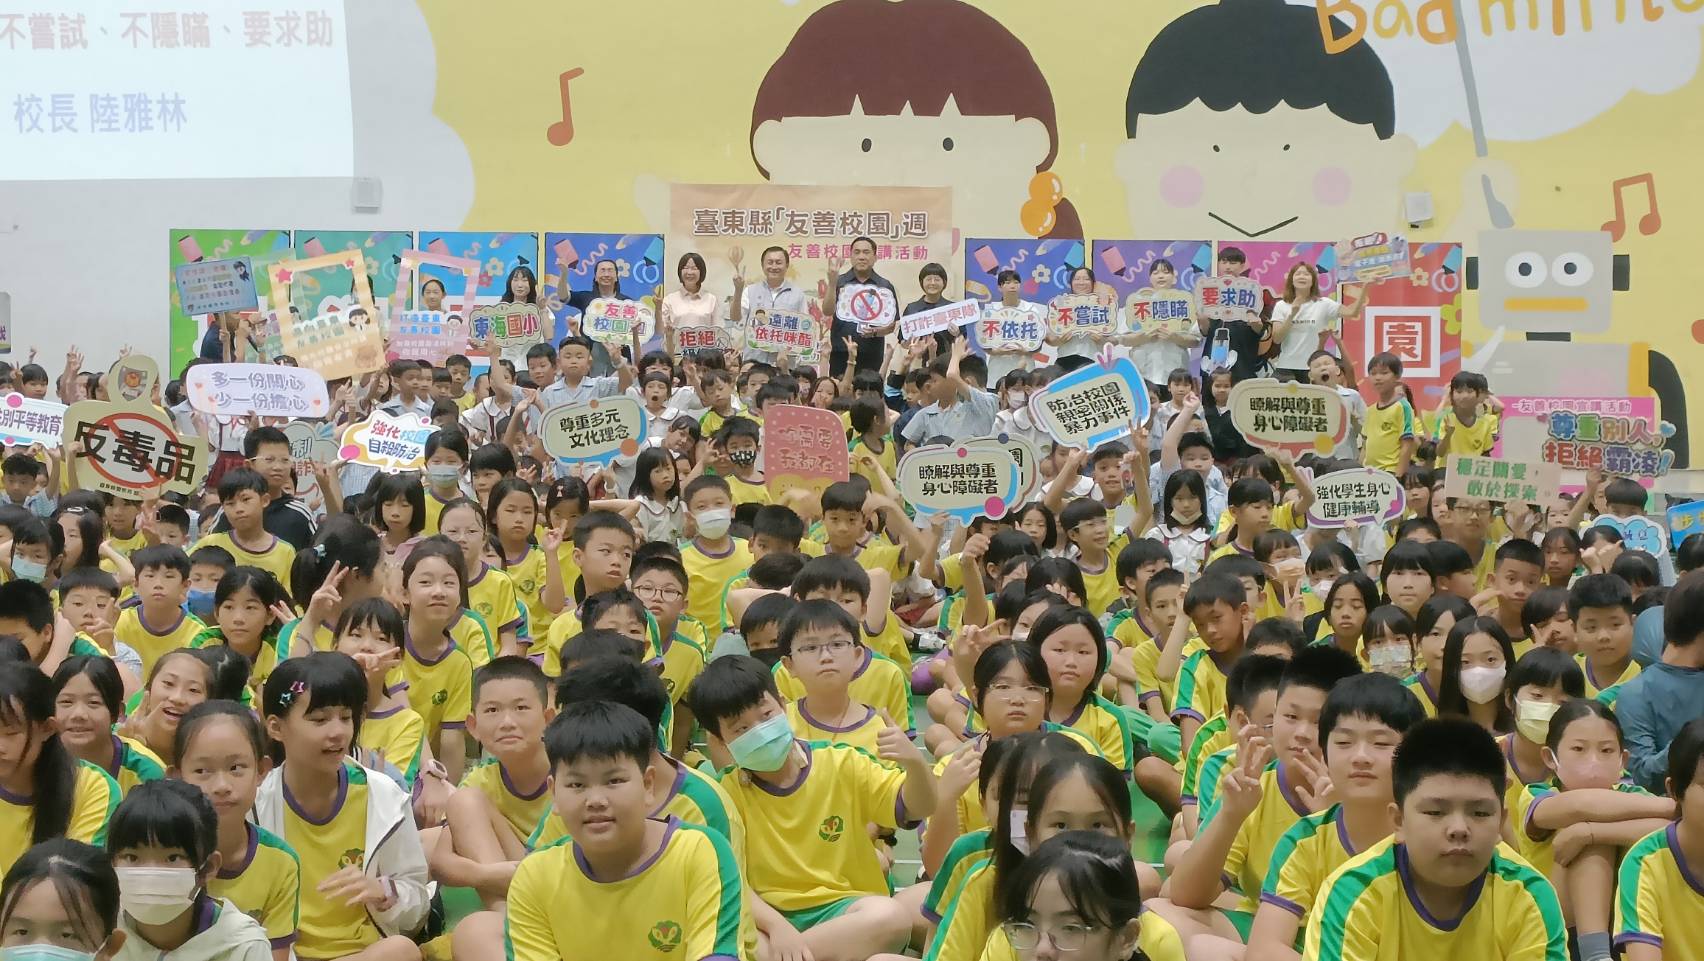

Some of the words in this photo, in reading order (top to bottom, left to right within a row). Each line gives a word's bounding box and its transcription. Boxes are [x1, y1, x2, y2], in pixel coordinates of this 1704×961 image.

[13, 93, 78, 133] 校長
[89, 92, 188, 133] 陸雅林
[693, 207, 928, 239] 臺東縣「友善校園」週
[788, 243, 928, 260] 友善校園講活動
[1202, 286, 1256, 308] 要求助
[604, 303, 636, 319] 友善
[1058, 305, 1110, 326] 不嘗試
[1133, 300, 1189, 321] 不隱瞞
[474, 313, 538, 338] 東海國小
[982, 320, 1038, 341] 不依托
[680, 330, 716, 347] 拒絕
[755, 327, 812, 348] 依托咪酯
[1046, 382, 1120, 413] 防治校園
[1249, 396, 1327, 416] 瞭解與尊重
[1055, 393, 1126, 424] 親密關係
[559, 408, 621, 433] 尊重多元
[1064, 405, 1130, 434] 暴力事件
[1253, 413, 1328, 432] 身心障礙者
[568, 424, 630, 449] 文化理念
[74, 420, 196, 485] 反毒品
[368, 437, 421, 460] 自殺防治
[918, 462, 997, 480] 瞭解與尊重
[921, 478, 999, 496] 身心障礙者
[1316, 481, 1391, 500] 強化學生身心
[1322, 499, 1381, 518] 健康輔導
